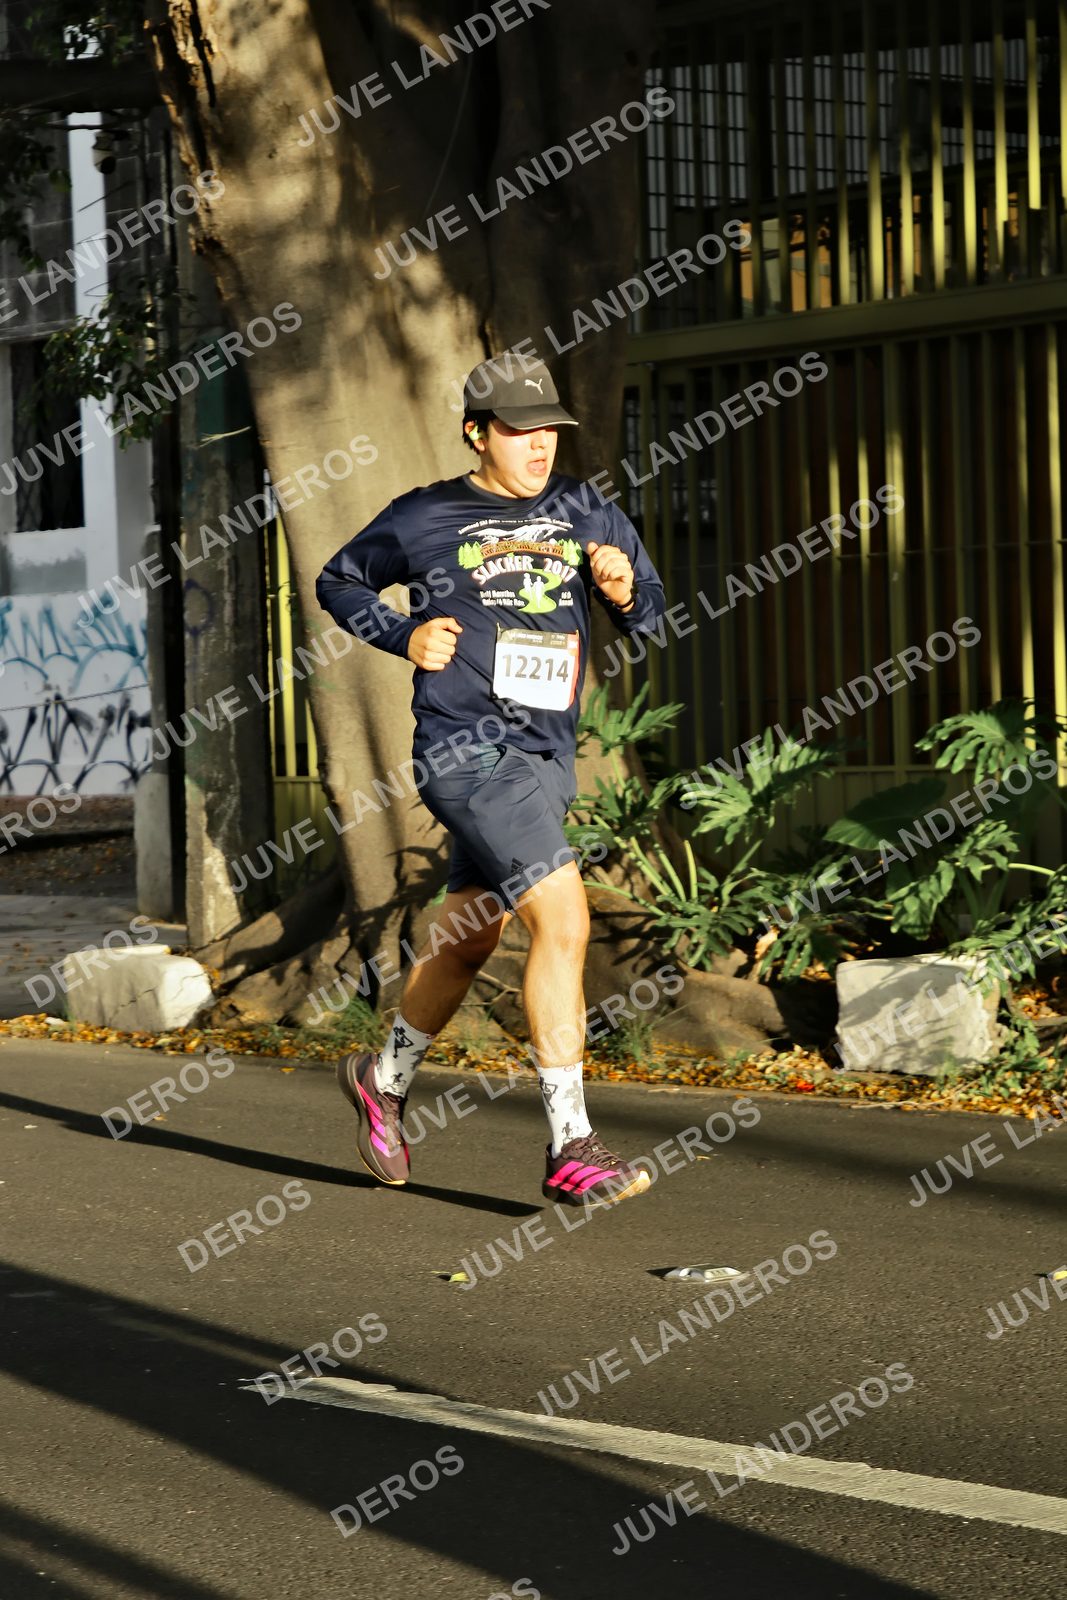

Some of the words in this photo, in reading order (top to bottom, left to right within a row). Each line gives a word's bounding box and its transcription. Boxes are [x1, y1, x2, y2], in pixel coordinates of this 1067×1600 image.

[471, 555, 534, 586] SLACKER
[543, 558, 577, 583] 2017
[502, 654, 569, 683] 12214
